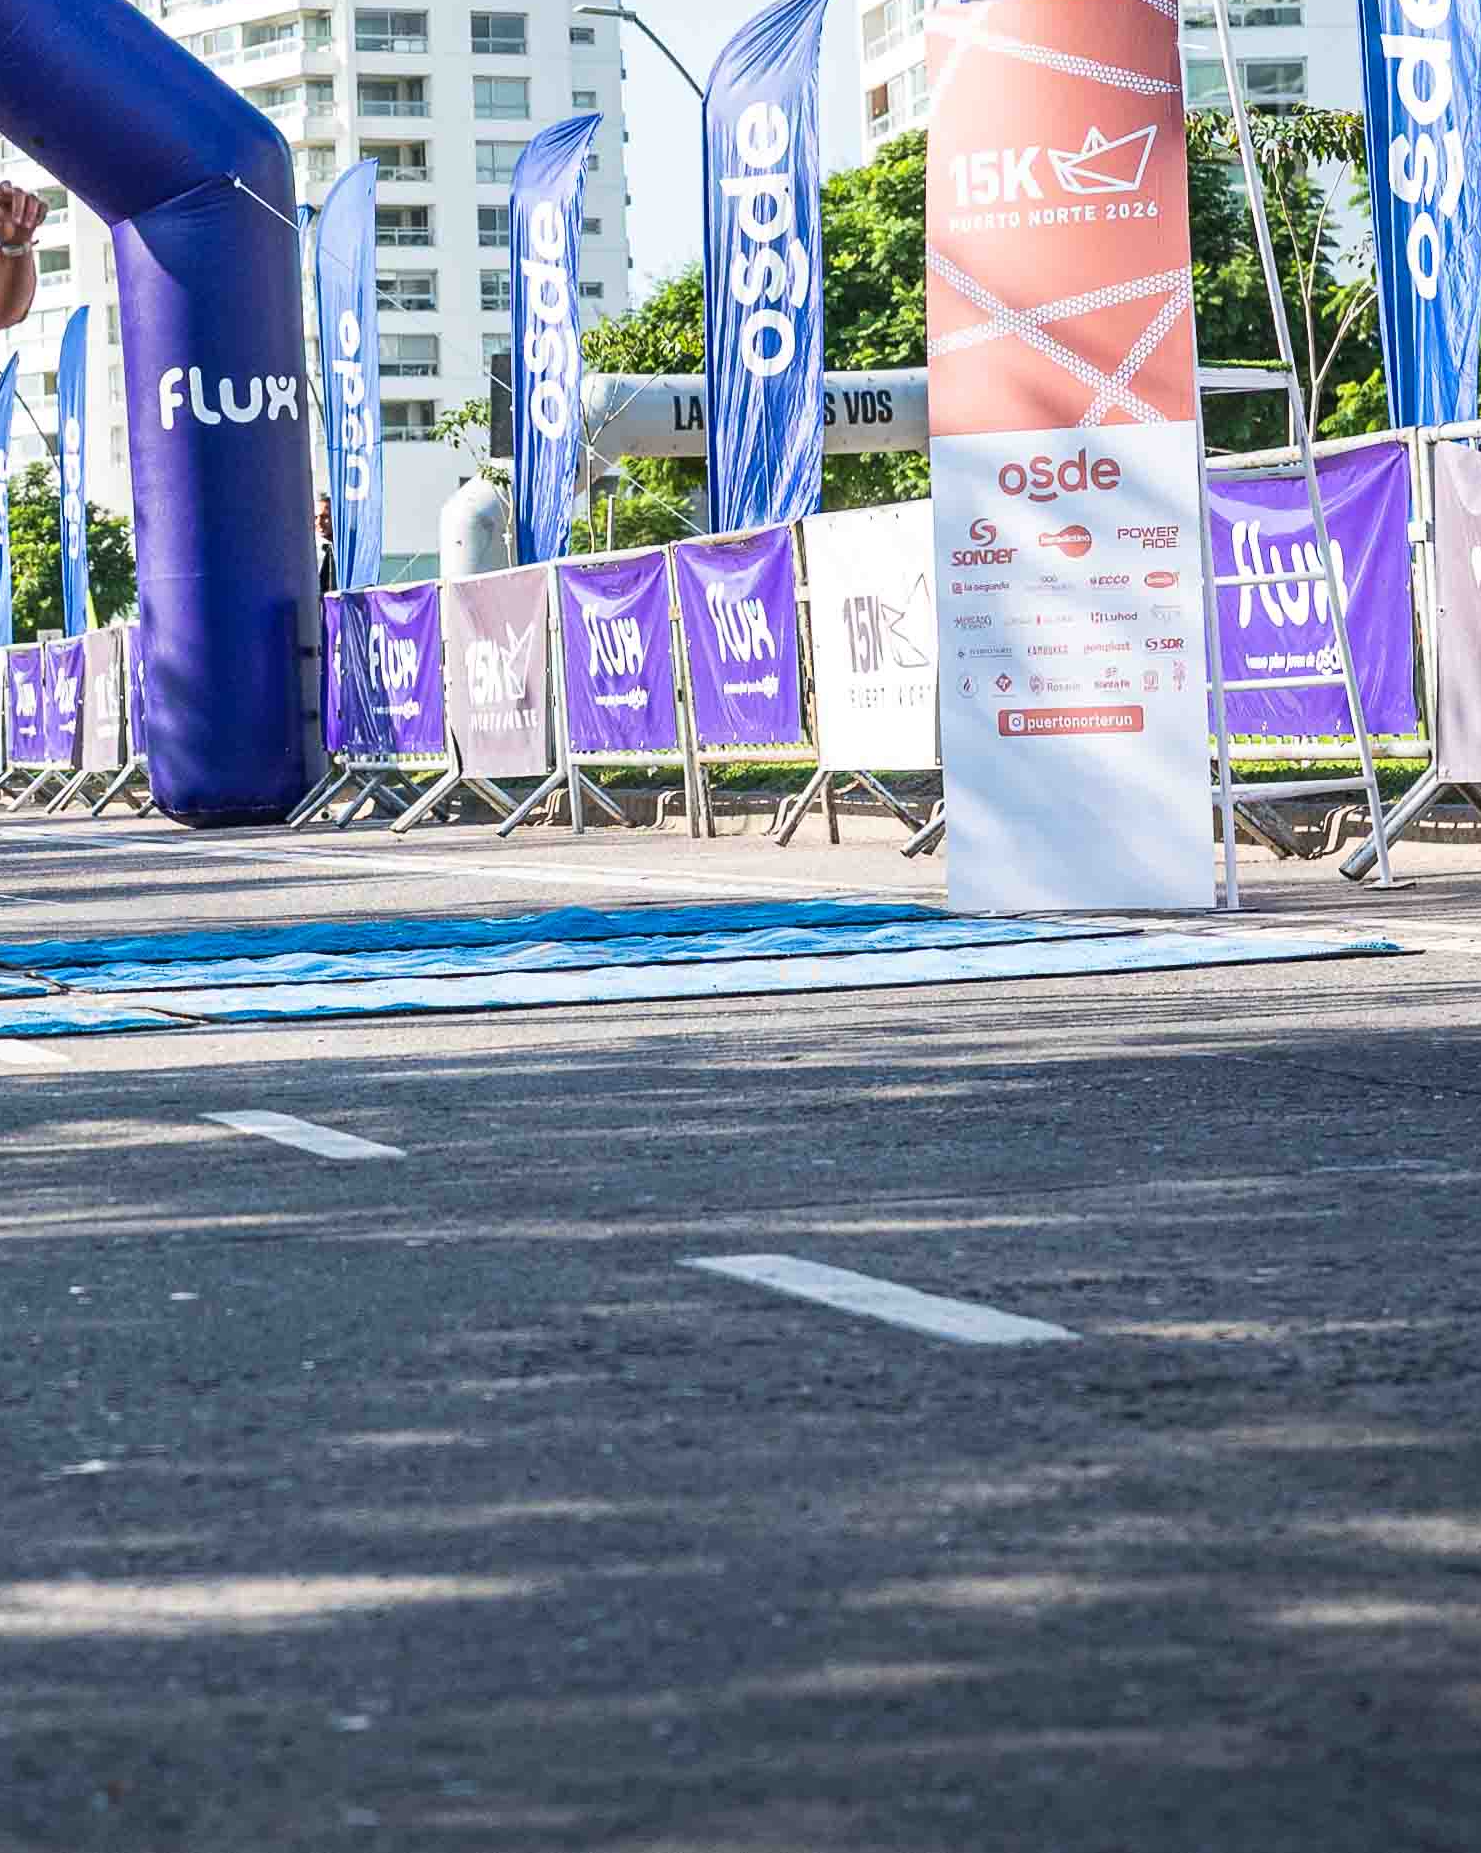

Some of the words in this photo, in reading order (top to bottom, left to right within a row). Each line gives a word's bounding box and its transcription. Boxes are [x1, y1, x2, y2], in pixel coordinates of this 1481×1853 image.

[948, 146, 1044, 205] 15K
[949, 209, 1021, 231] PUERTO
[1028, 206, 1096, 227] NORTE
[1105, 201, 1159, 219] 2026
[720, 101, 806, 378] osde
[521, 201, 577, 440] osde
[159, 366, 299, 429] flux
[673, 395, 704, 430] LA
[842, 389, 893, 425] VOS
[999, 447, 1121, 502] osde
[1117, 526, 1179, 540] POWER
[1142, 537, 1178, 549] ADE
[1160, 637, 1185, 649] SDR
[1316, 644, 1346, 675] osd
[1027, 714, 1133, 731] puertonorterun
